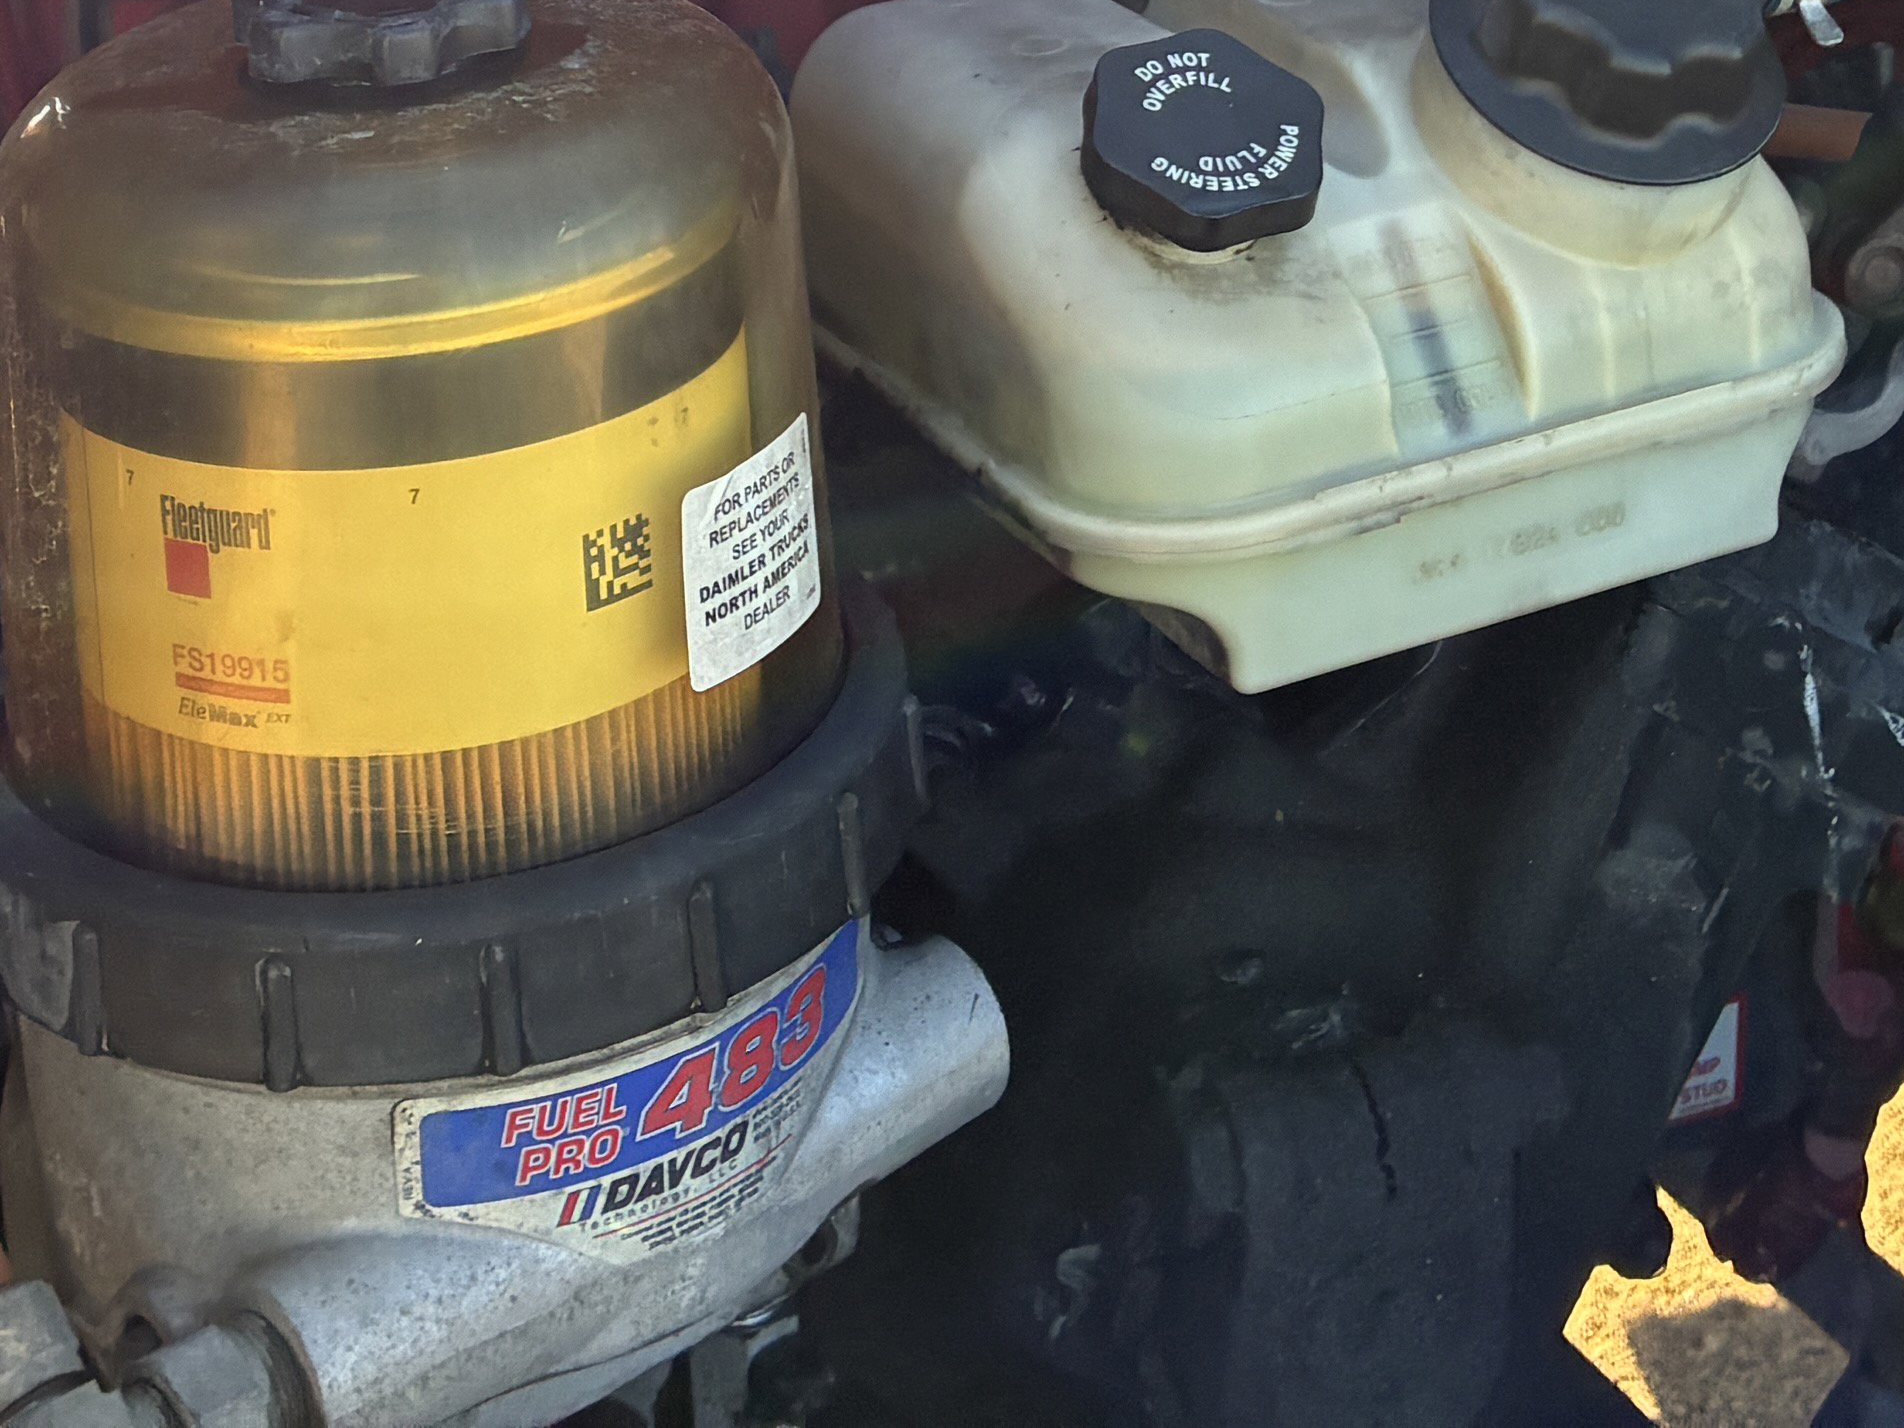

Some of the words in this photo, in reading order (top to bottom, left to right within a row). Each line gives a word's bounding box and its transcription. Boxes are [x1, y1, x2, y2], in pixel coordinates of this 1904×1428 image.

[1134, 60, 1163, 83] DO
[1167, 51, 1211, 70] NOT
[1142, 70, 1232, 113] OVERFILL
[1151, 156, 1261, 192] STEERING
[1199, 143, 1267, 172] FLUID
[1259, 124, 1299, 180] POWER
[126, 469, 134, 486] 7
[408, 488, 420, 505] 7
[714, 493, 742, 522] FOR
[744, 464, 780, 504] PARTS
[782, 451, 795, 473] OR
[160, 494, 271, 554] Fleetguard
[709, 472, 800, 549] REPLACEMENTS
[732, 538, 757, 561] SEE
[760, 508, 790, 545] YOUR
[700, 553, 766, 604] DAIMLER
[769, 512, 809, 561] TRUCKS
[705, 584, 758, 627] NORTH
[762, 539, 809, 594] AMERICA
[744, 585, 790, 630] DEALER
[172, 643, 291, 684] FS19915
[503, 1083, 627, 1148] FUEL
[636, 965, 827, 1144] 483
[515, 1125, 623, 1186] PRO
[601, 1119, 749, 1216] DAVCO
